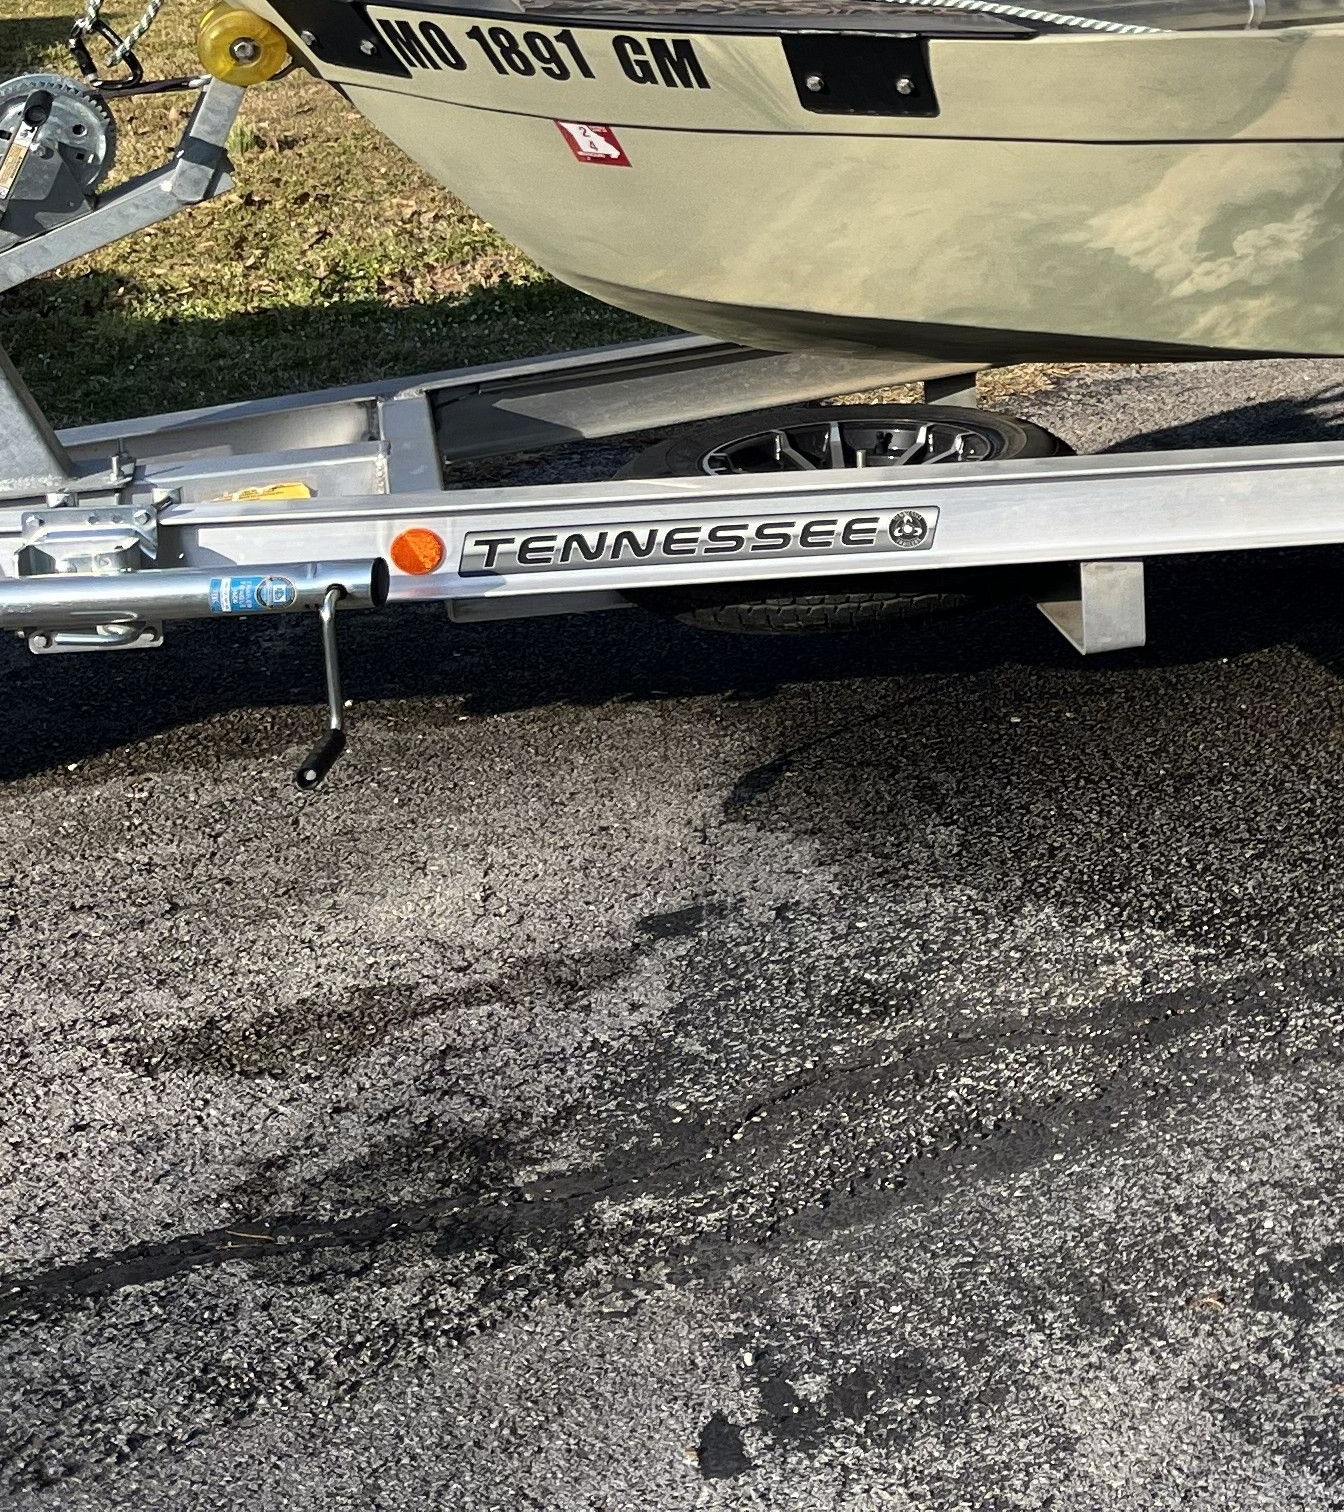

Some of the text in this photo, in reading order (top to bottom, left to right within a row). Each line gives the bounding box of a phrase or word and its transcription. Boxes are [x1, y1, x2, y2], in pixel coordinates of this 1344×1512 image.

[376, 19, 711, 89] MO 1891 GM
[474, 516, 881, 569] TENNESSEE
